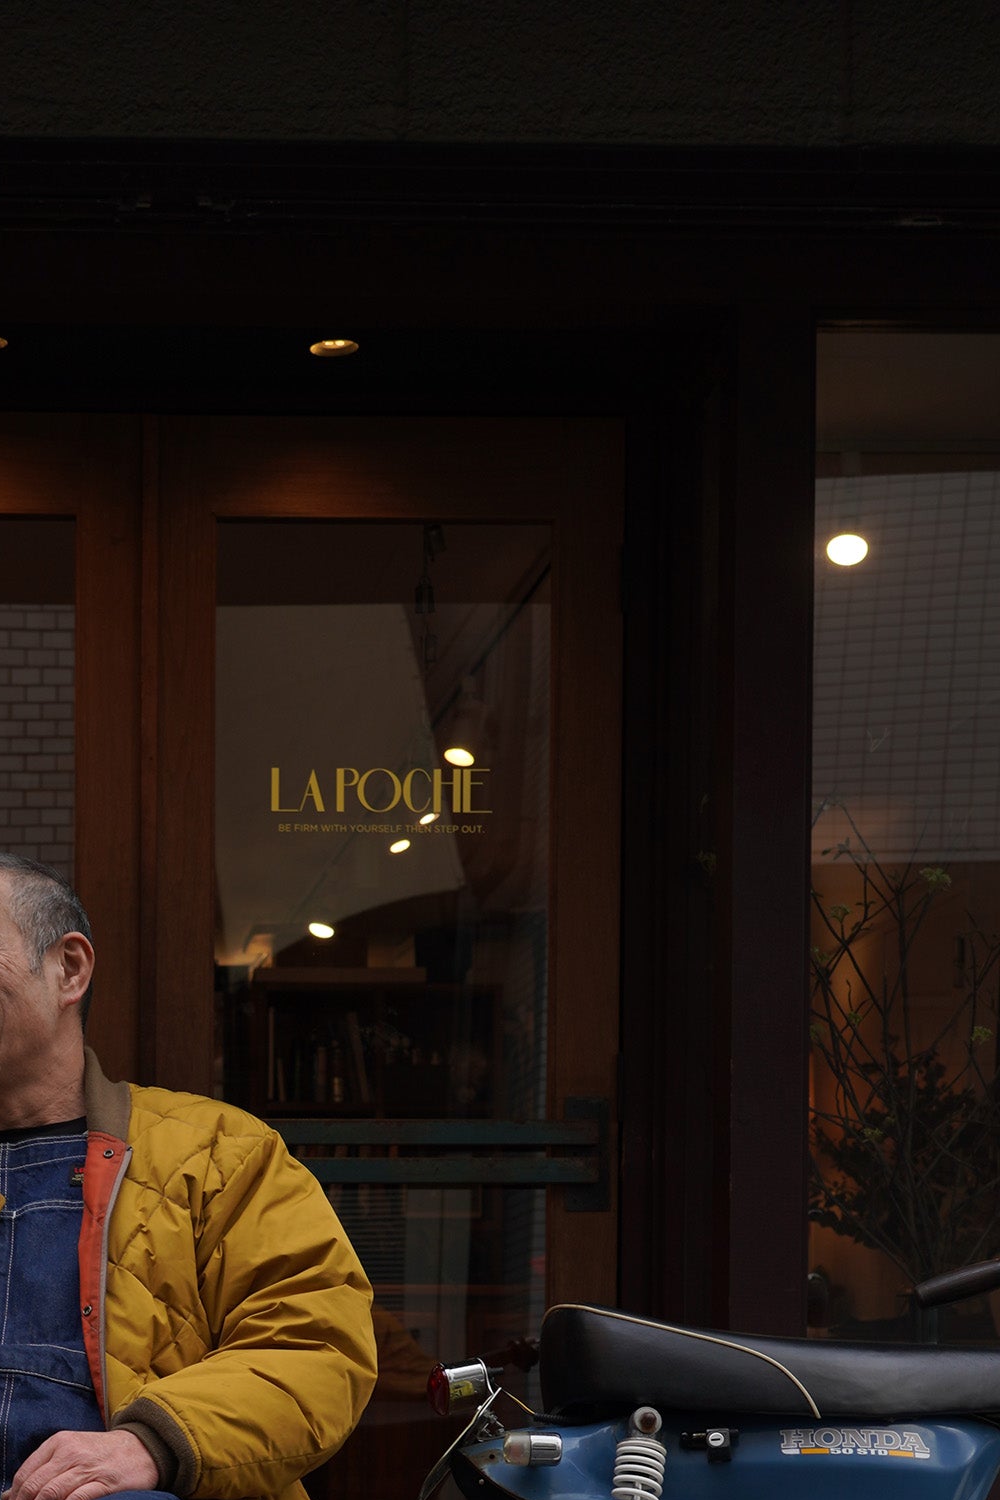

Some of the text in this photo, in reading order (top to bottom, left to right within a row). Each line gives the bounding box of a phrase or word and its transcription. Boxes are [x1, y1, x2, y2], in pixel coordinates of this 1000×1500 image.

[278, 824, 291, 832] BE
[294, 824, 318, 832] FIRM
[321, 824, 347, 832] WITH
[350, 824, 402, 833] YOURSELF
[405, 824, 431, 833] THEN
[434, 825, 459, 833] STEP
[780, 1428, 930, 1452] HONDA
[856, 1448, 888, 1456] STD
